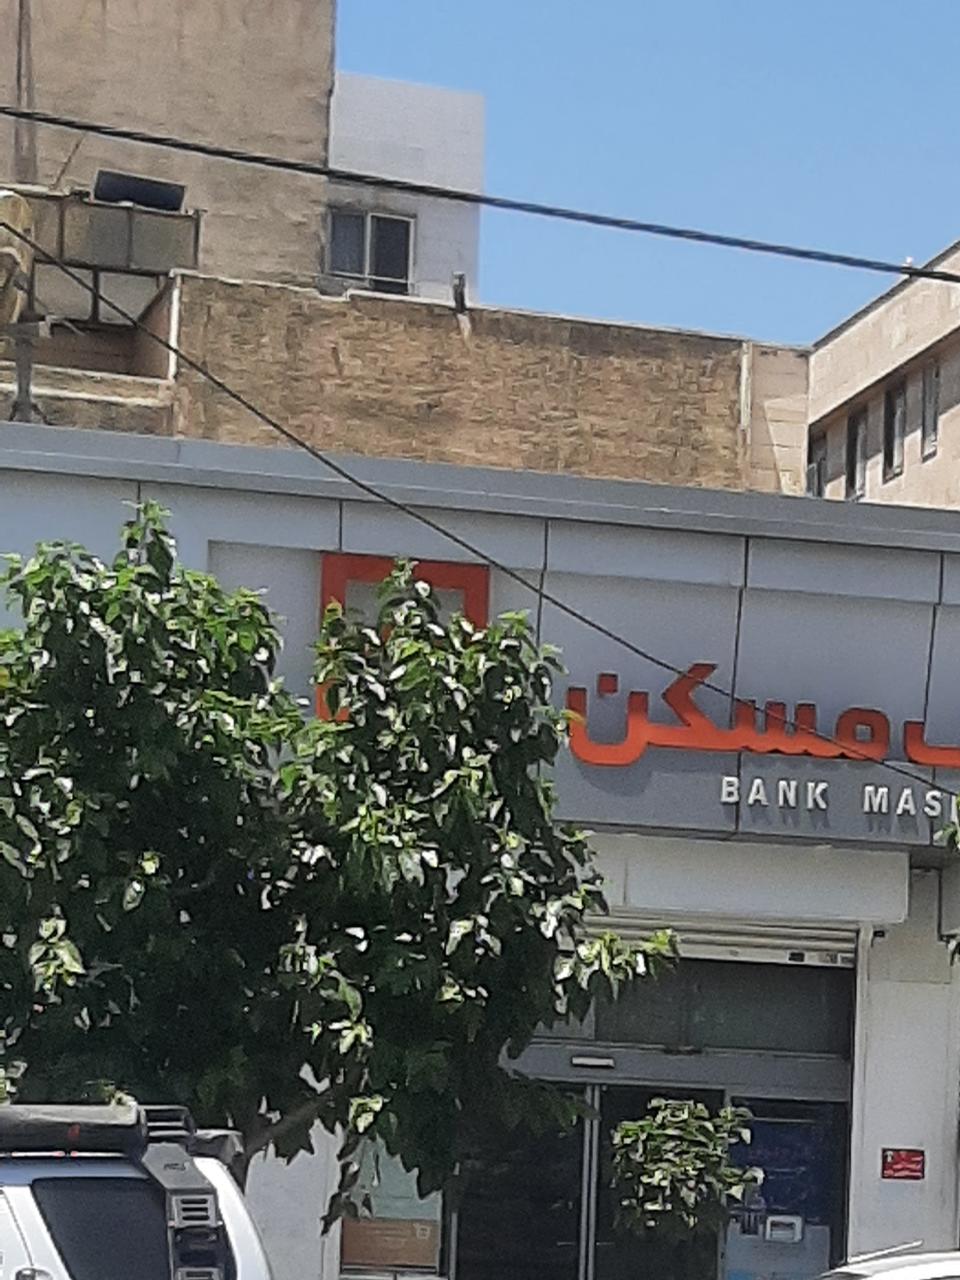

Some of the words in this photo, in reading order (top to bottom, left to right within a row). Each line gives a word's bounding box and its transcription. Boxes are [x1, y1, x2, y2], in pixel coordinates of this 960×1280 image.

[566, 663, 890, 767] مسکن
[720, 776, 829, 810] BANK
[862, 785, 960, 822] MAS
